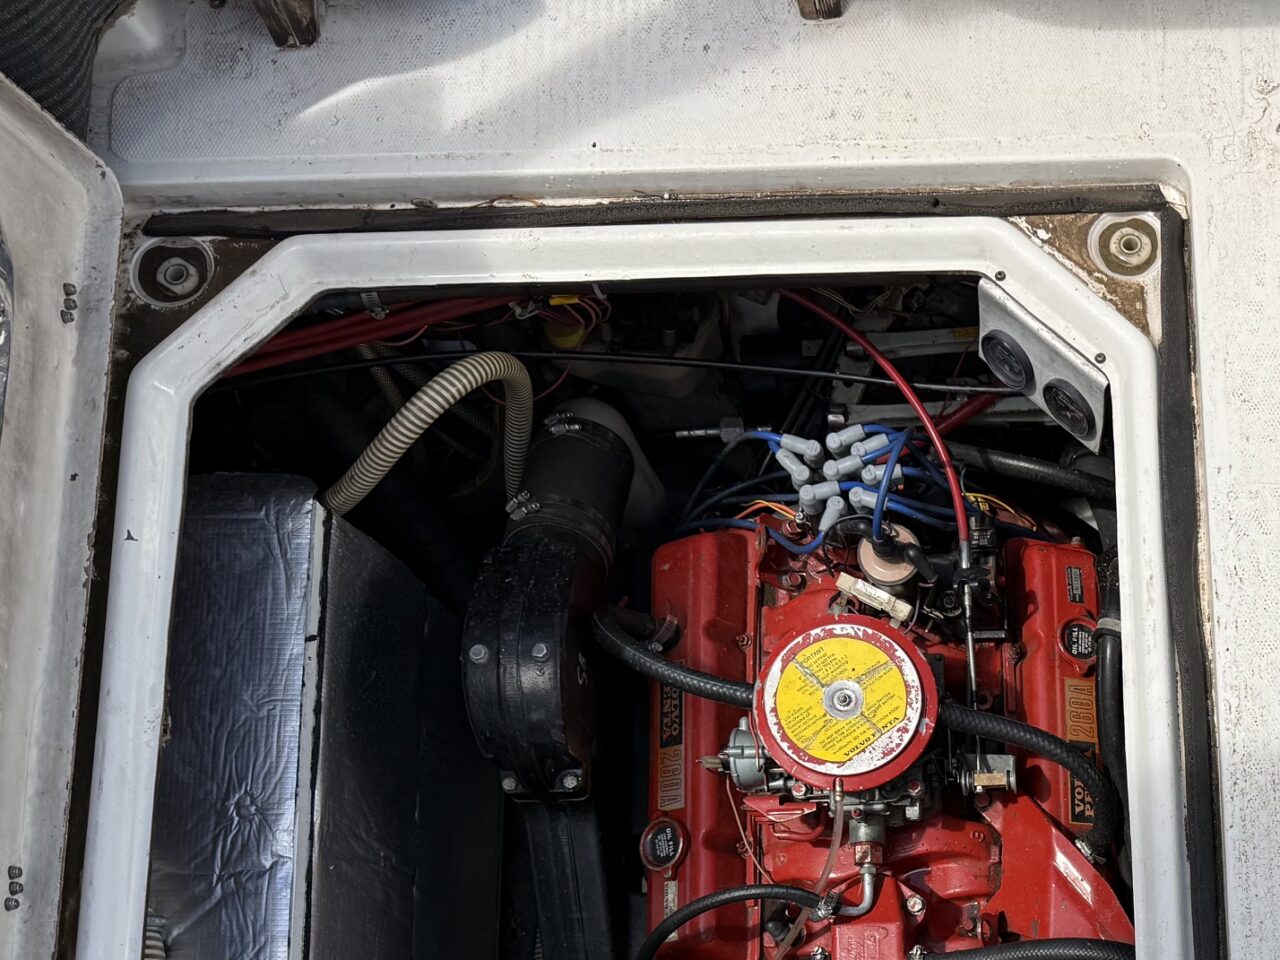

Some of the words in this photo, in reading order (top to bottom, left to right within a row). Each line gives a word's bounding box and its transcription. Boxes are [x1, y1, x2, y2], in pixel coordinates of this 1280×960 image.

[794, 646, 824, 669] IPORTANT
[662, 685, 671, 741] ENTA
[671, 687, 679, 735] OLVO
[843, 735, 871, 757] VOLVO
[870, 715, 899, 738] PNTA
[1068, 684, 1094, 738] 260A
[660, 750, 681, 807] 260A
